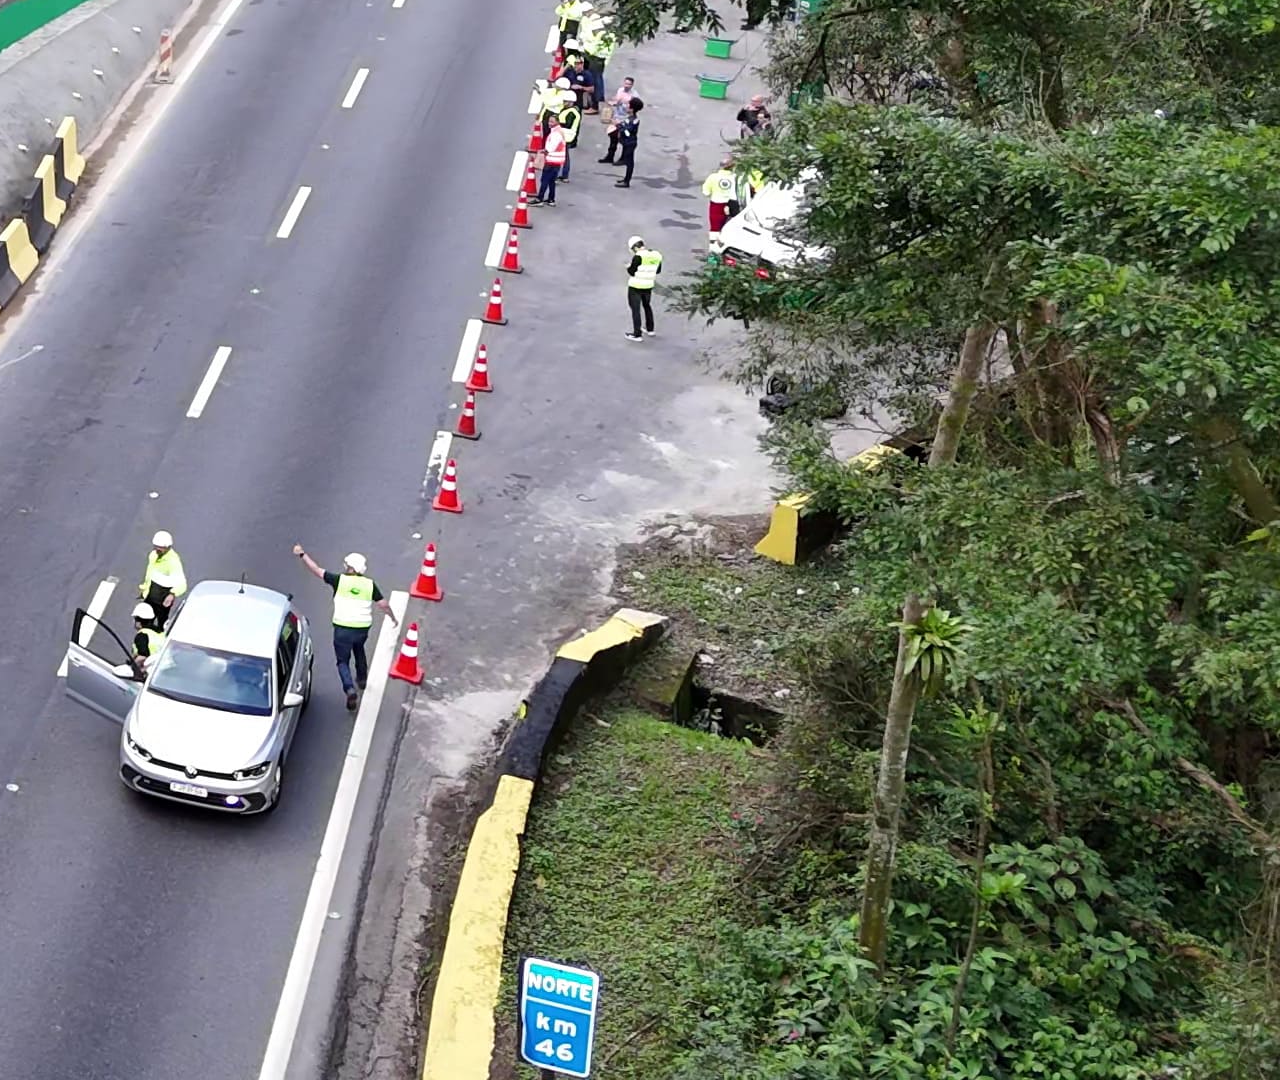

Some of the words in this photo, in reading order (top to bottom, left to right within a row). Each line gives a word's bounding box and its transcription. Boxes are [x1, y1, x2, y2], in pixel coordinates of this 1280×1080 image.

[528, 972, 593, 1003] NORTE
[536, 1011, 577, 1038] km
[534, 1038, 575, 1062] 46
